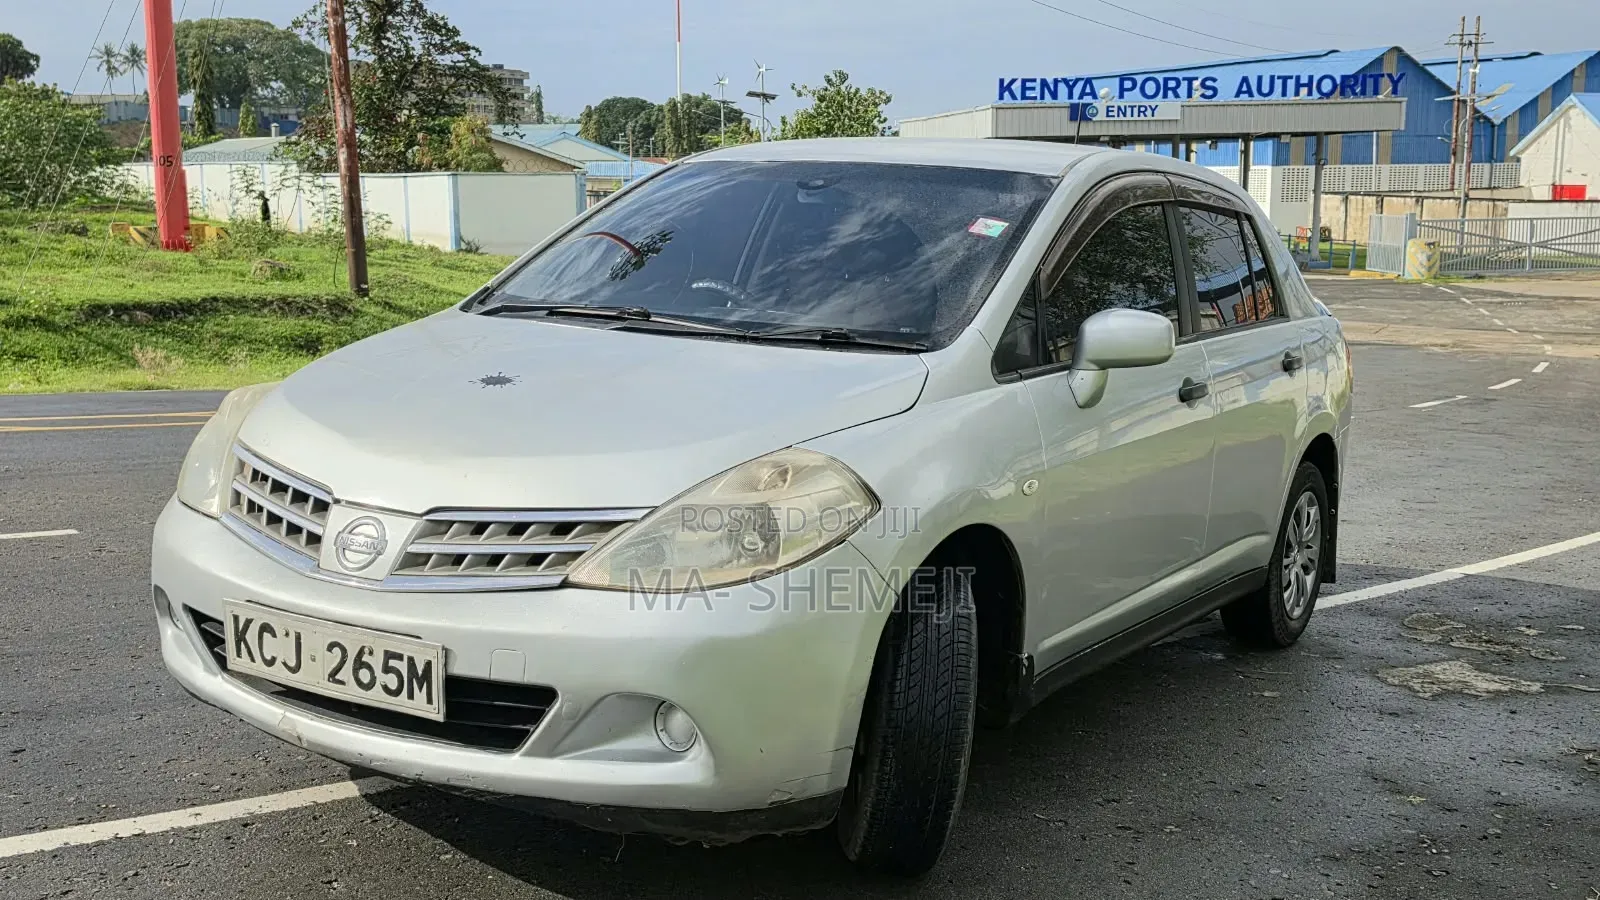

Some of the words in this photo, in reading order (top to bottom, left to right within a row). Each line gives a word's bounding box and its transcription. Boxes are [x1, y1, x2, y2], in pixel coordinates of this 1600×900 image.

[999, 77, 1099, 101] KENYA
[1118, 76, 1219, 100] PORTS
[1234, 72, 1407, 99] AUTHORITY
[1105, 104, 1159, 118] ENTRY
[339, 535, 379, 551] NISSAN
[232, 613, 302, 675] KCJ
[326, 640, 433, 706] 265M
